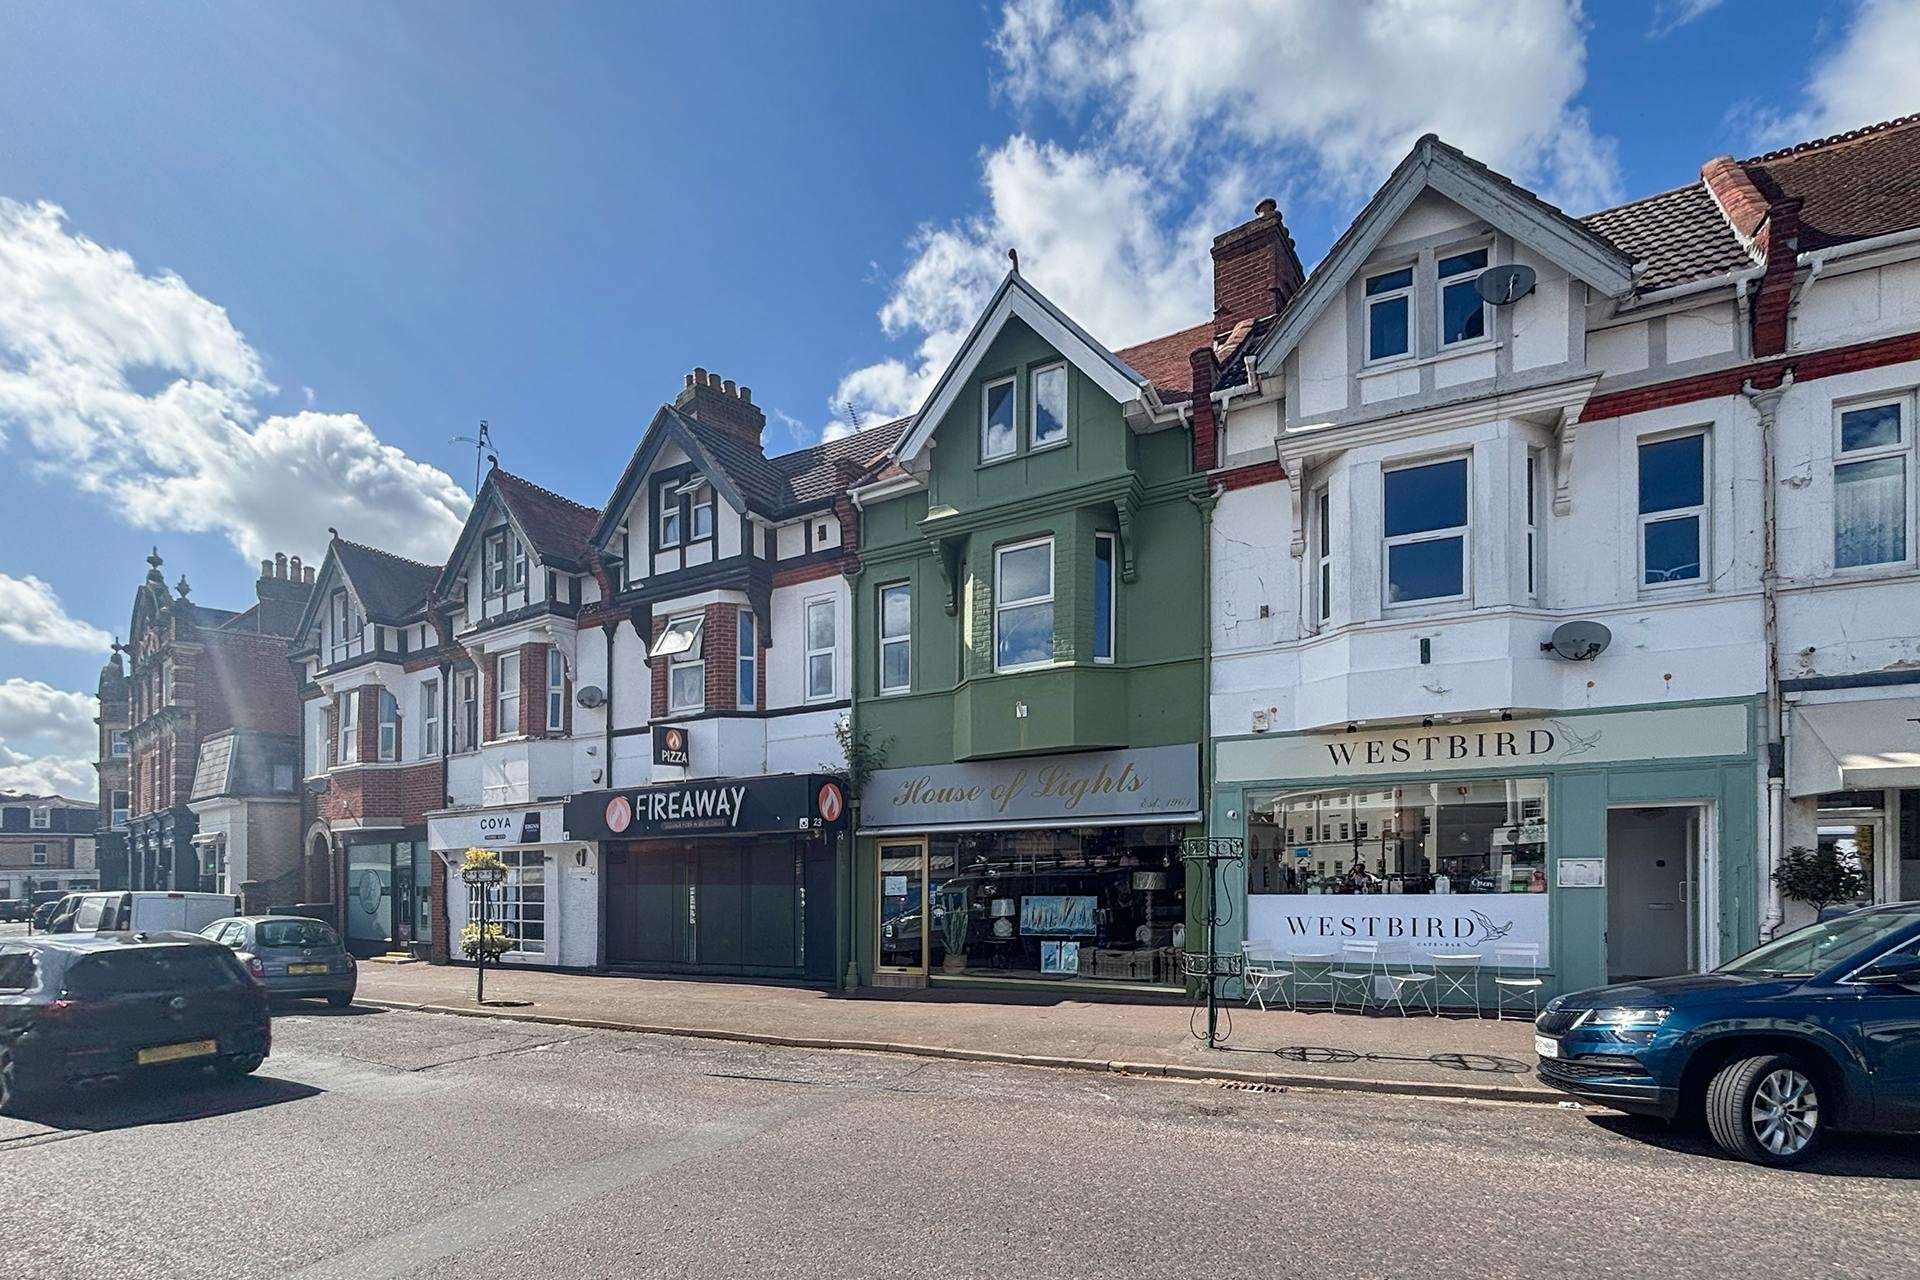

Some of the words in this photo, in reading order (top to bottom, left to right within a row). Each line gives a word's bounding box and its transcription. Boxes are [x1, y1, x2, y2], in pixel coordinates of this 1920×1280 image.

[661, 750, 688, 763] PIZZA
[1325, 729, 1555, 766] WESTBIRD
[893, 775, 984, 806] House
[990, 768, 1028, 812] of
[1031, 762, 1148, 810] Lights
[636, 786, 746, 827] FIREAWAY
[480, 817, 511, 830] COYA
[813, 817, 822, 827] 23
[1284, 915, 1475, 938] WESTBIRD
